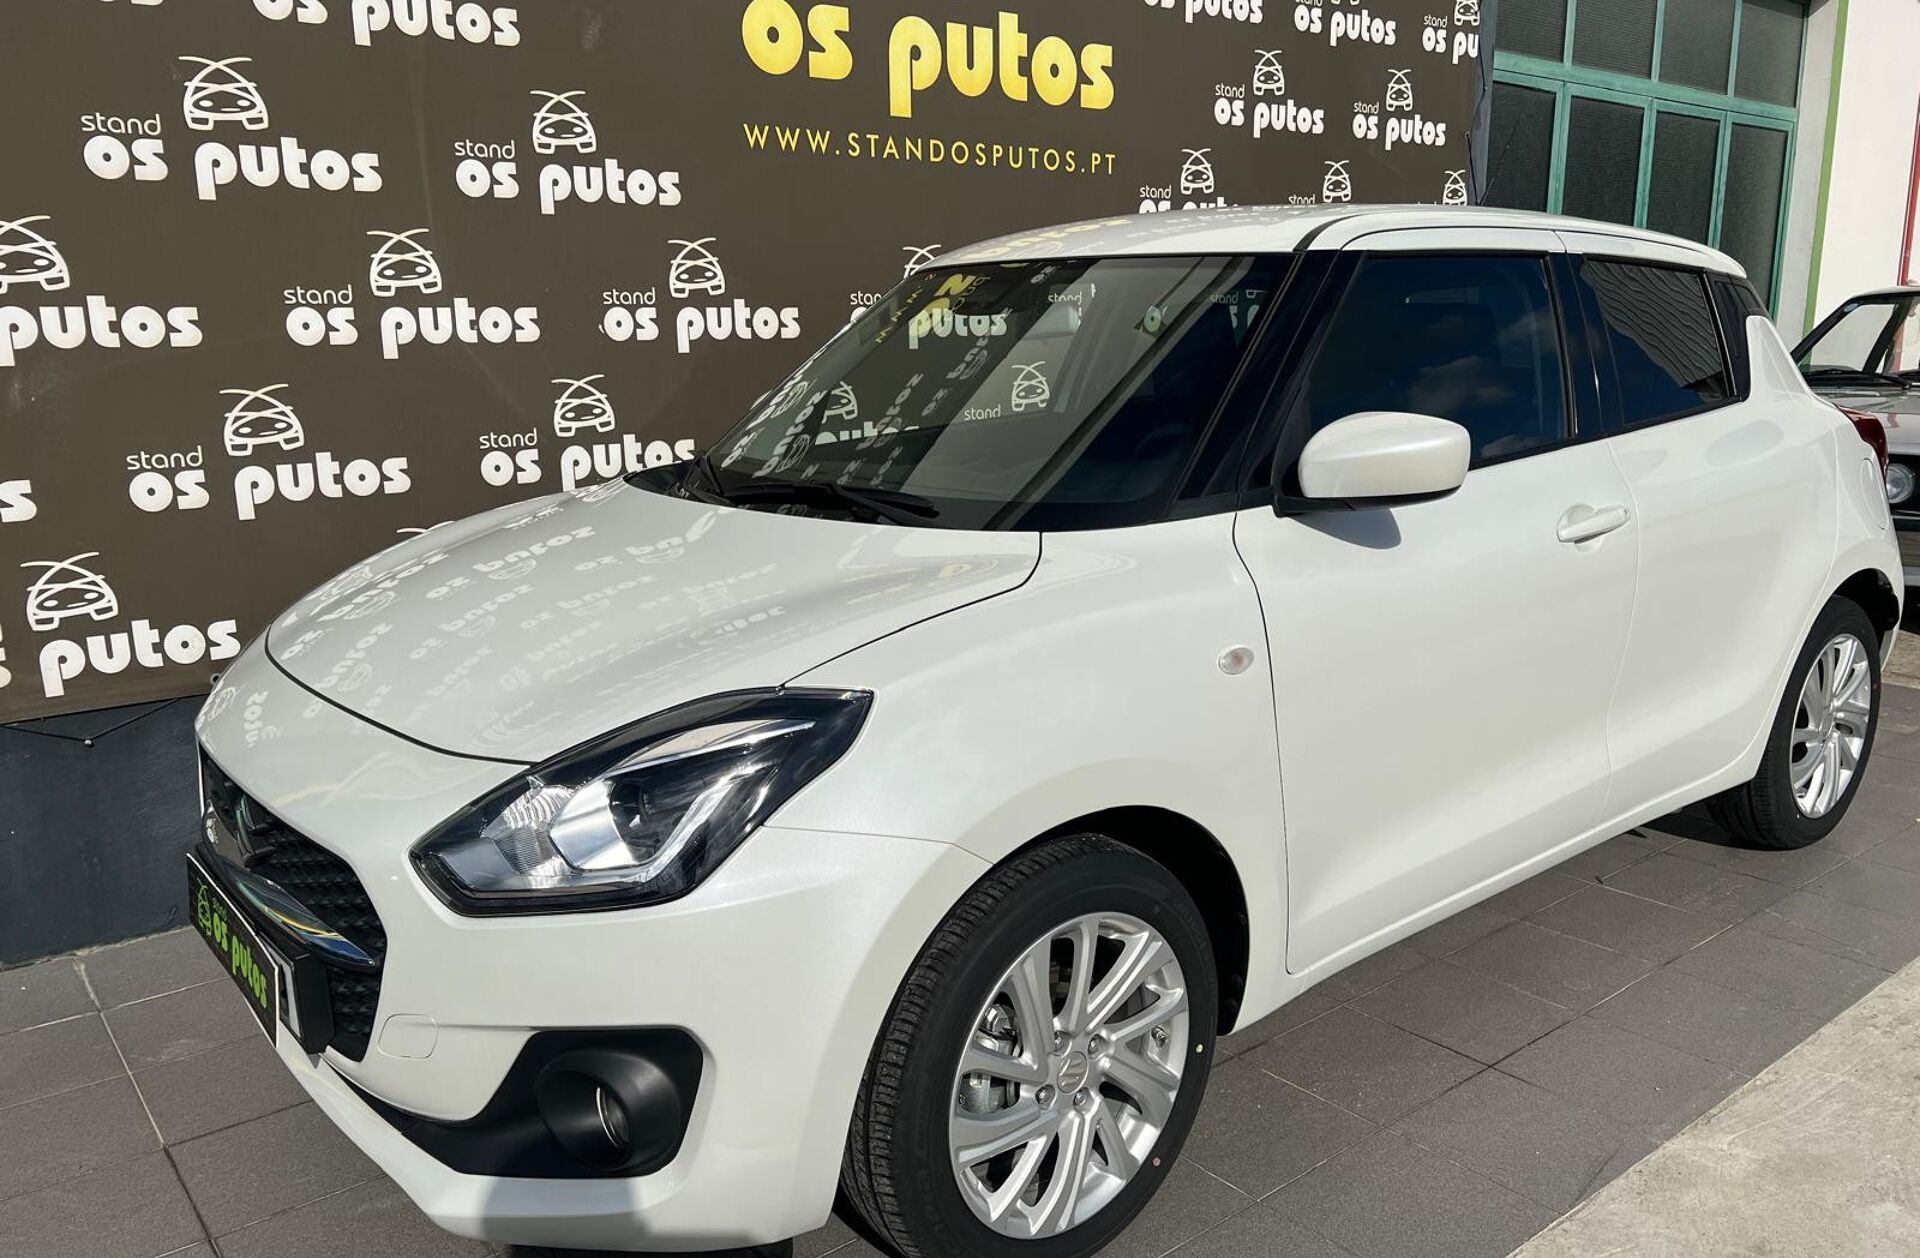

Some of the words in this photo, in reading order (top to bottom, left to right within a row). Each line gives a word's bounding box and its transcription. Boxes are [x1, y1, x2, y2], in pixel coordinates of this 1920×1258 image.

[352, 0, 520, 46] putos
[1294, 4, 1322, 33] os
[1330, 10, 1396, 46] putos
[1423, 27, 1446, 53] os
[1424, 15, 1447, 28] stand
[742, 0, 852, 79] os
[889, 11, 1114, 118] putos
[1215, 84, 1244, 98] stand
[1354, 102, 1379, 115] stand
[81, 113, 161, 135] stand
[1214, 98, 1244, 126] os
[1254, 99, 1324, 138] putos
[1353, 114, 1378, 139] os
[1385, 114, 1446, 150] putos
[84, 135, 168, 180] os
[195, 137, 382, 200] putos
[455, 139, 515, 159] stand
[744, 124, 1115, 174] WWW.STANDOSPUTOS.PT
[456, 159, 519, 198] os
[540, 159, 681, 214] putos
[1140, 185, 1171, 199] stand
[284, 284, 352, 304] stand
[603, 287, 655, 305] stand
[0, 295, 203, 366] putos
[286, 307, 358, 346] os
[380, 298, 540, 359] putos
[604, 307, 659, 341] os
[677, 298, 800, 353] putos
[964, 404, 1001, 420] stand
[127, 446, 203, 470] stand
[479, 428, 538, 449] stand
[481, 449, 541, 486] os
[561, 434, 695, 492] putos
[128, 470, 209, 512] os
[234, 452, 411, 520] putos
[39, 619, 240, 698] putos
[232, 935, 268, 1009] putos
